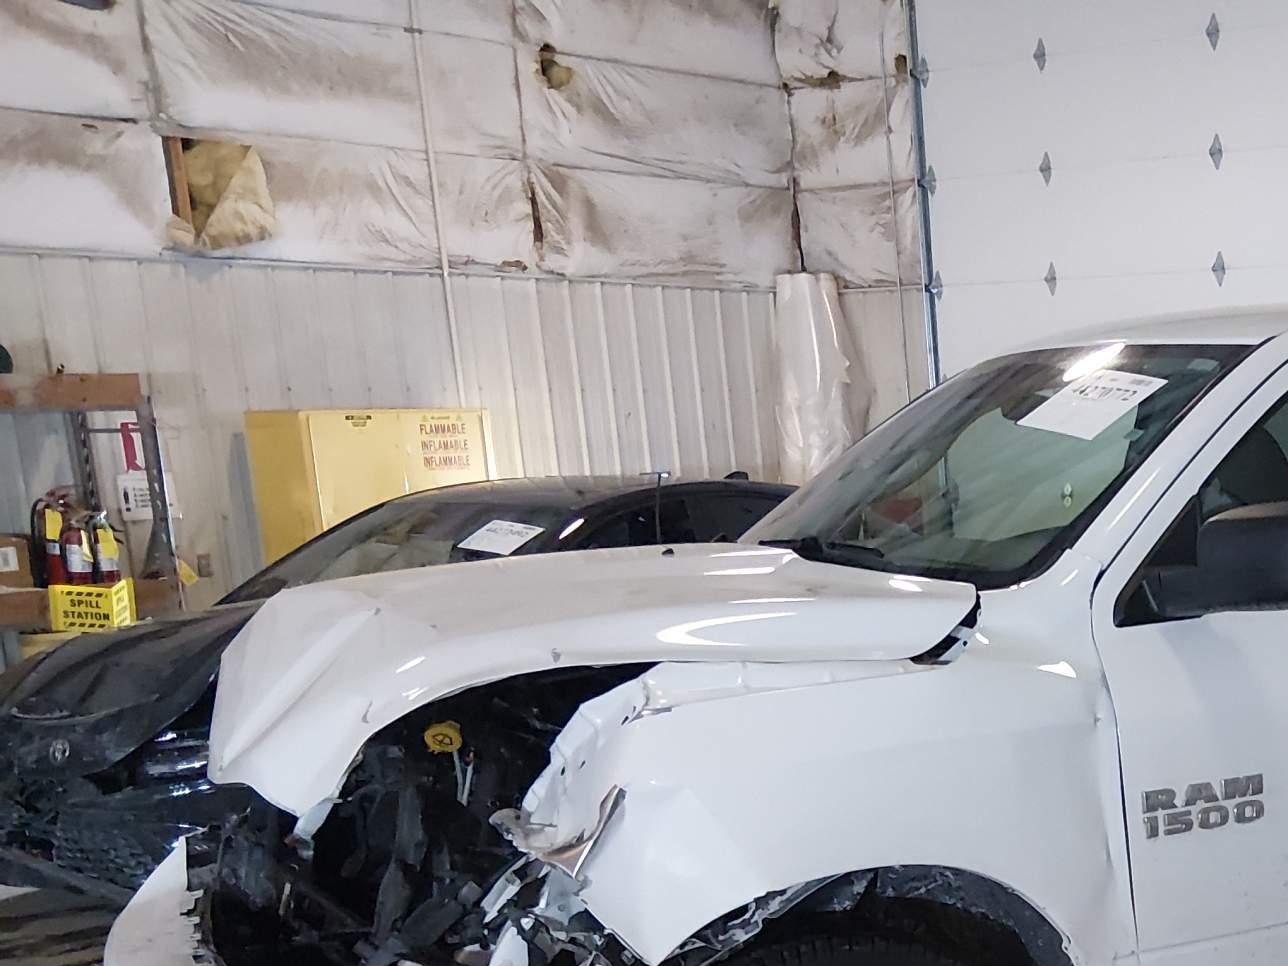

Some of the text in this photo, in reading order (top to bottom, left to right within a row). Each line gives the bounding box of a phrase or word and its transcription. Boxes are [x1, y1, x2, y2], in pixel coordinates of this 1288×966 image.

[419, 423, 466, 435] FLAMMABLE
[421, 439, 469, 451] INFLAMABLE
[423, 455, 470, 467] INFLAMMABLE
[69, 598, 102, 609] SPILL
[62, 610, 110, 621] STATION
[1141, 773, 1264, 814] RAM
[1143, 800, 1265, 839] 1500
